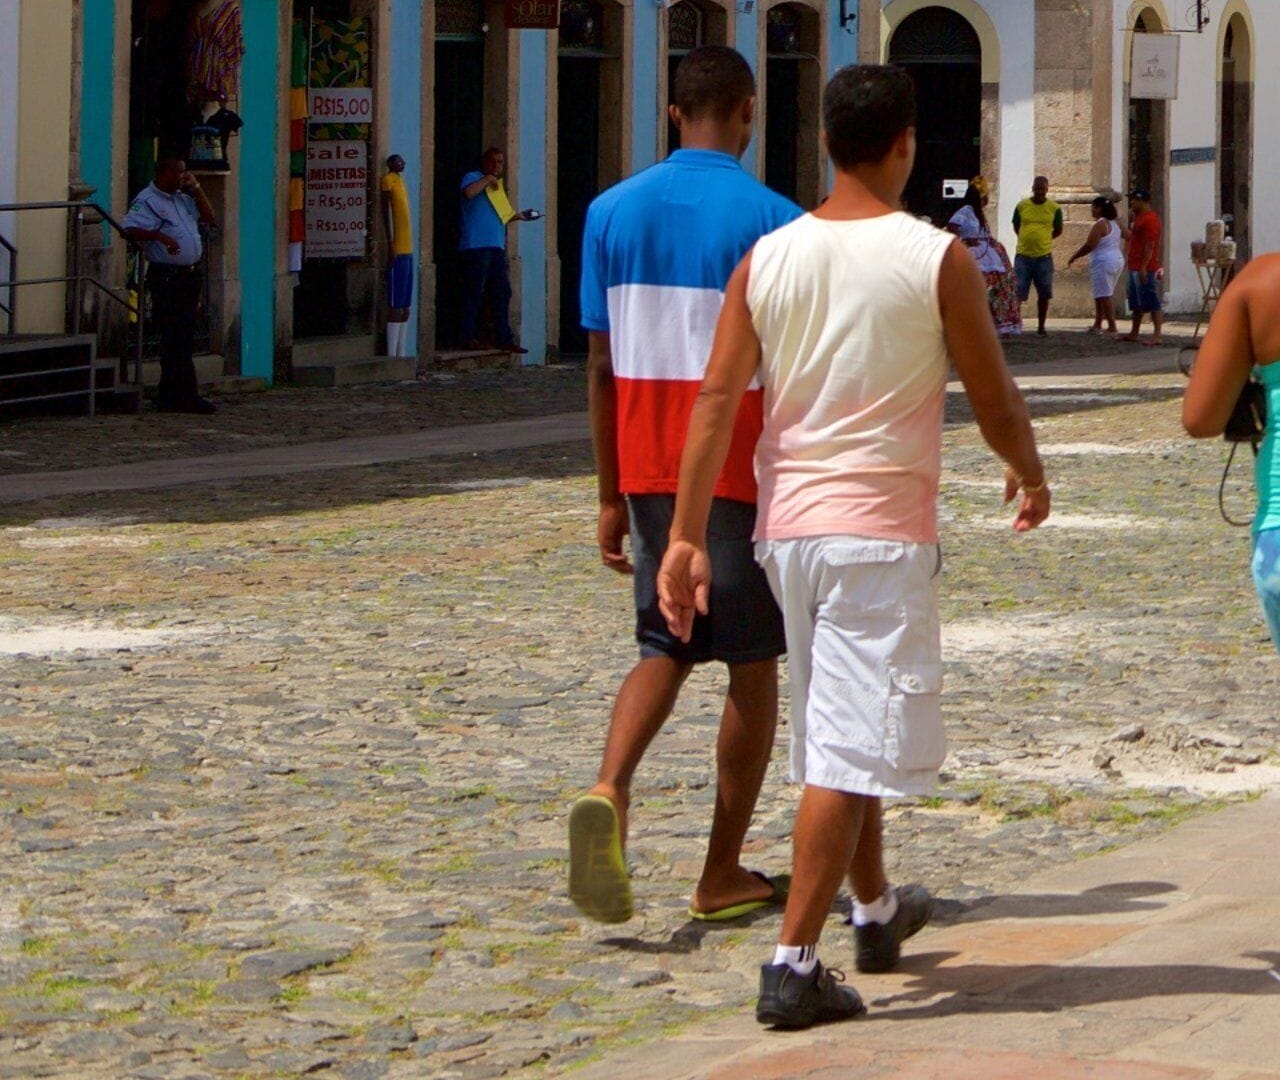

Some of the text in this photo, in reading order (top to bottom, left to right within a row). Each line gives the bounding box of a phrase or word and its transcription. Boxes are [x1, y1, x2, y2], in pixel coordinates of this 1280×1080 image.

[313, 96, 369, 118] R$15,00
[308, 167, 366, 180] MISETAS
[319, 194, 362, 210] R$5,00
[316, 219, 364, 234] R$10,00
